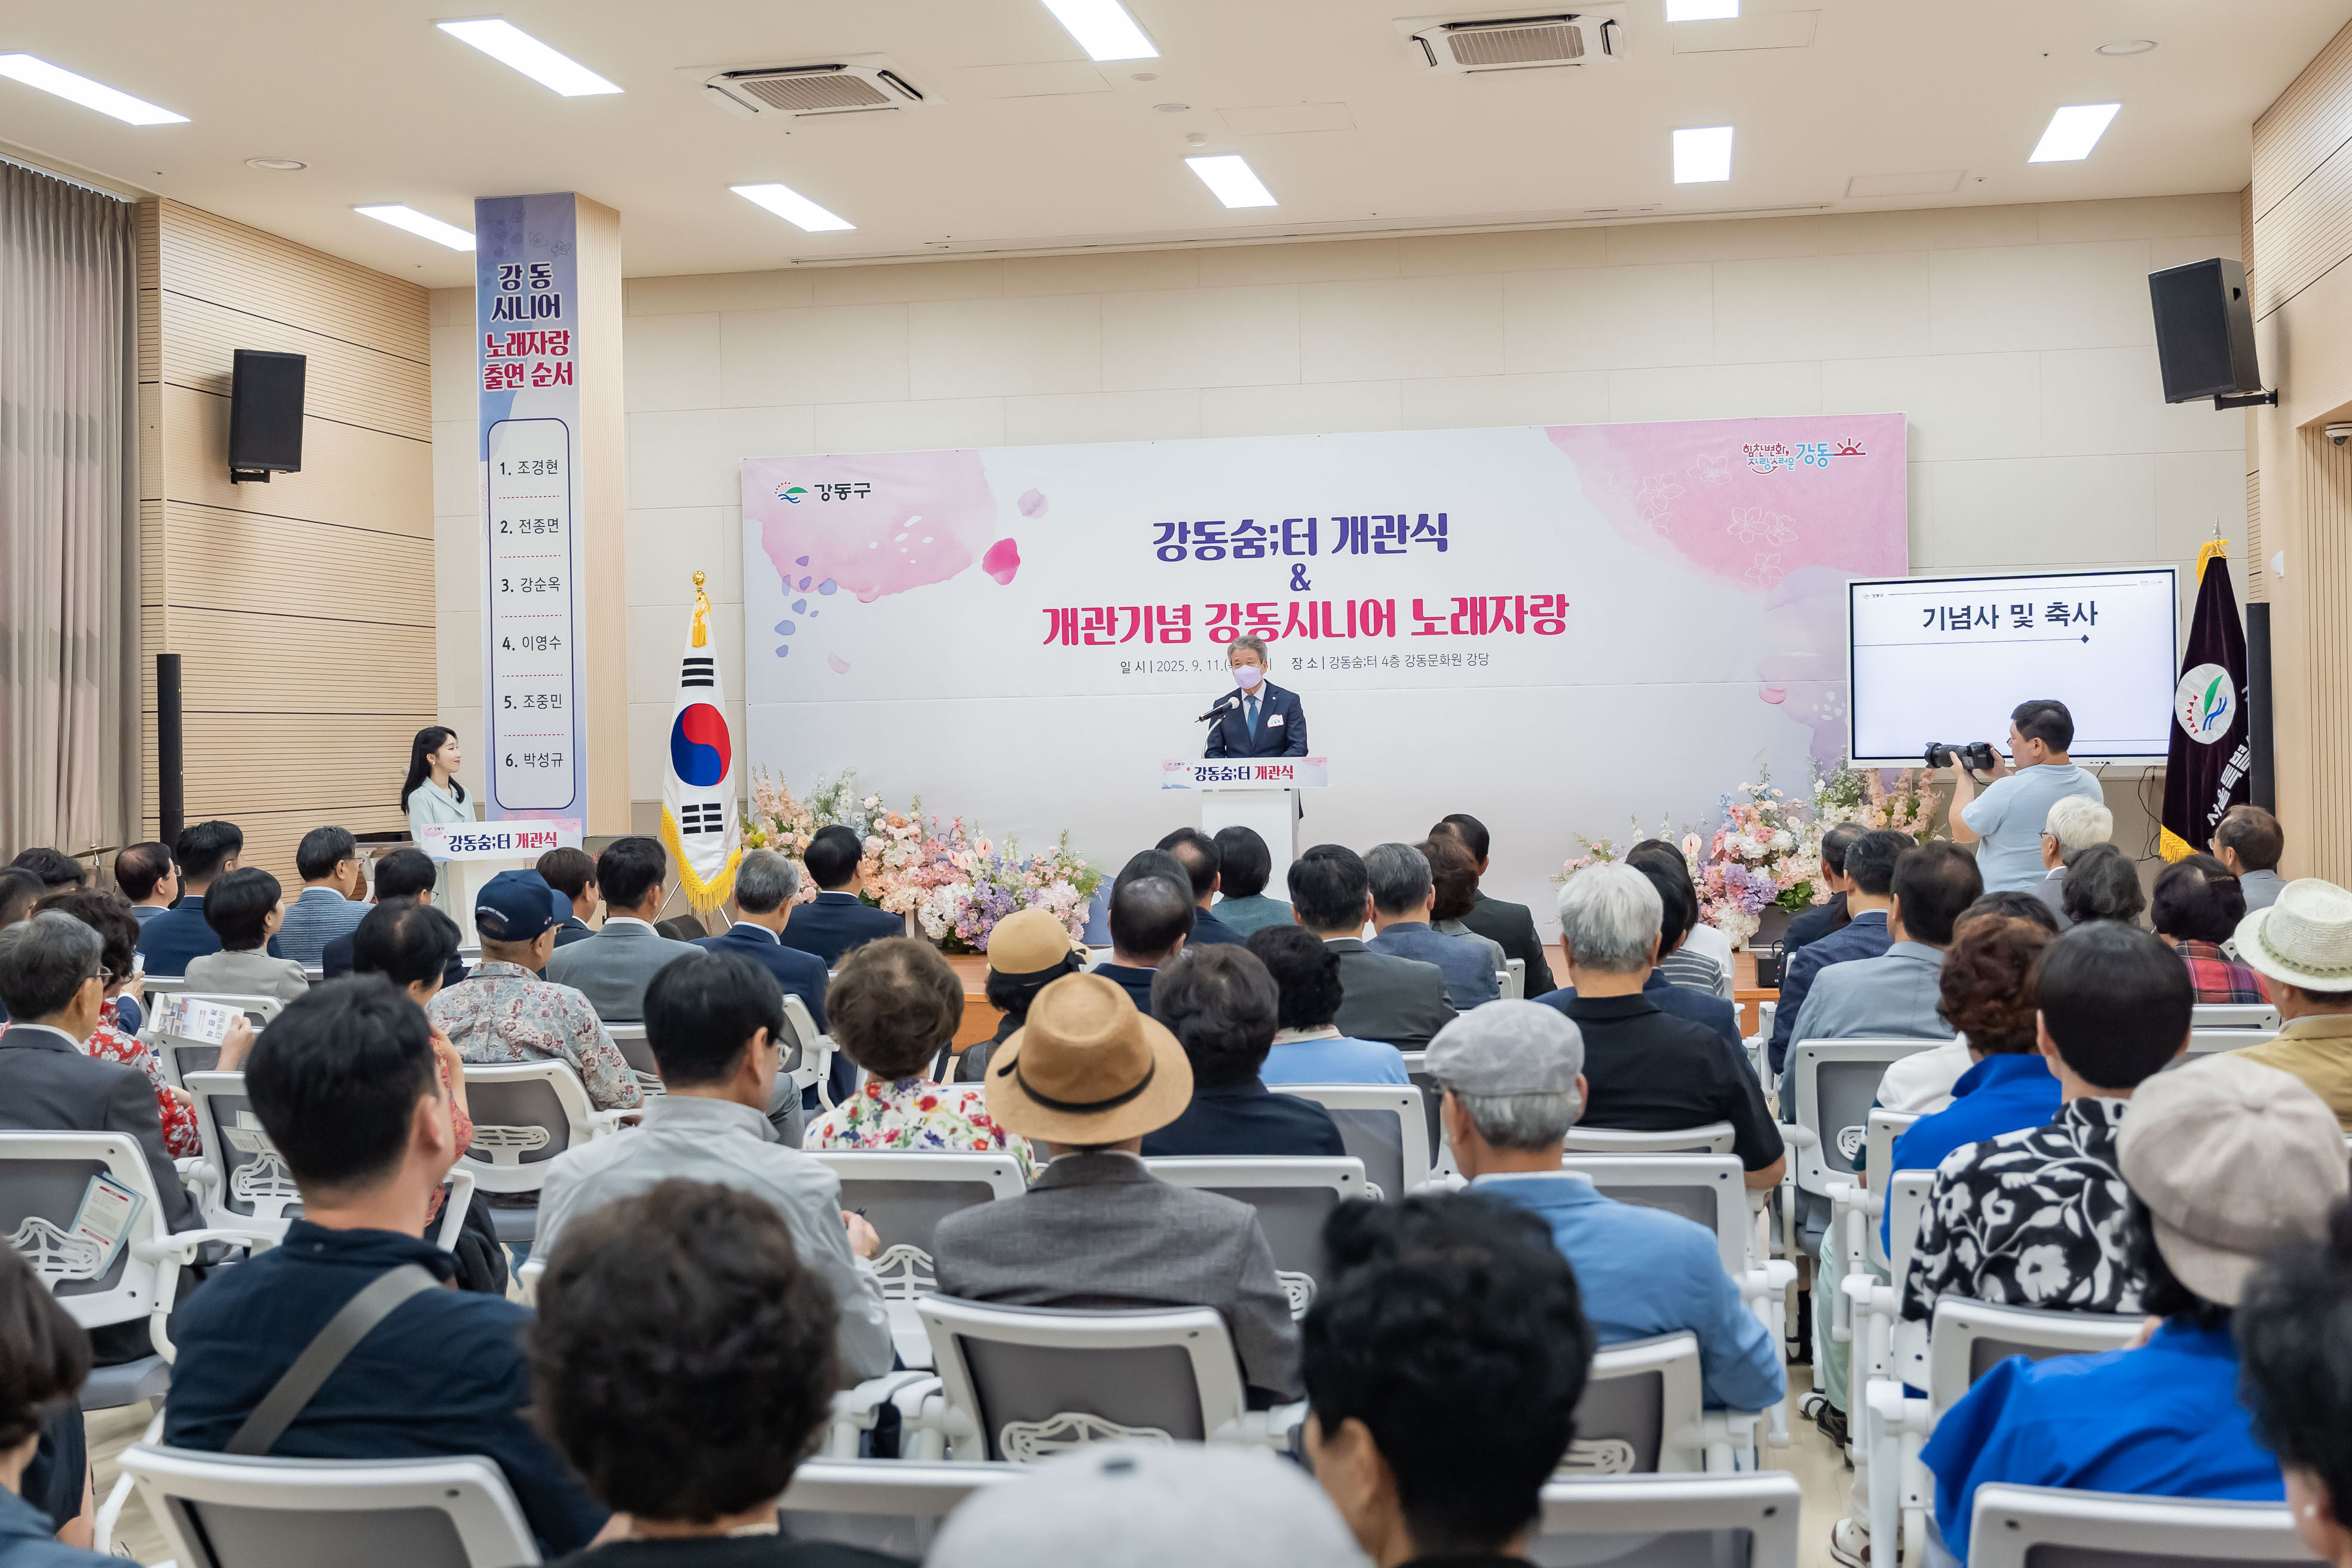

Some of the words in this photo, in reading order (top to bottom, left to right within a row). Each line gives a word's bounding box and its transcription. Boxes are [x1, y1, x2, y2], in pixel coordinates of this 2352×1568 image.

[491, 293, 560, 321] 시니어
[487, 329, 569, 357] 노래자랑
[485, 364, 524, 390] 출연
[531, 362, 572, 387] 순서
[1795, 443, 1830, 468] 강동
[500, 463, 511, 475] 1.
[518, 460, 558, 475] 조경현
[1748, 457, 1794, 474] 자랑스러운
[814, 483, 871, 501] 강동구
[501, 520, 512, 534] 2.
[519, 518, 559, 534] 전종면
[1153, 517, 1318, 562] 강동숨;터
[1331, 513, 1448, 555] 개관식
[502, 579, 513, 592] 3.
[521, 577, 561, 592] 강순옥
[1290, 564, 1310, 591] &
[1043, 605, 1191, 645] 개관기념
[1205, 599, 1396, 643] 강동시니어
[1411, 594, 1569, 635] 노래자랑
[1923, 605, 1999, 630] 기념사
[2011, 604, 2034, 628] 및
[2045, 601, 2098, 626] 축사
[503, 637, 514, 651] 4.
[523, 636, 562, 651] 이영수
[1157, 661, 1187, 671] 2025.
[1193, 660, 1201, 671] 9.
[1330, 656, 1377, 669] 강동숨;터
[1382, 655, 1400, 667] 4층
[1405, 654, 1462, 667] 강동문화원
[1467, 653, 1489, 666] 강당
[505, 696, 516, 709] 5.
[523, 694, 562, 709] 조중민
[506, 754, 517, 767] 6.
[525, 753, 564, 767] 박성규
[1195, 767, 1250, 781] 강동숨;터
[1255, 765, 1293, 779] 개관식
[2207, 735, 2251, 827] 서울특별
[449, 834, 510, 852] 강동숨;터
[515, 831, 558, 849] 개관식
